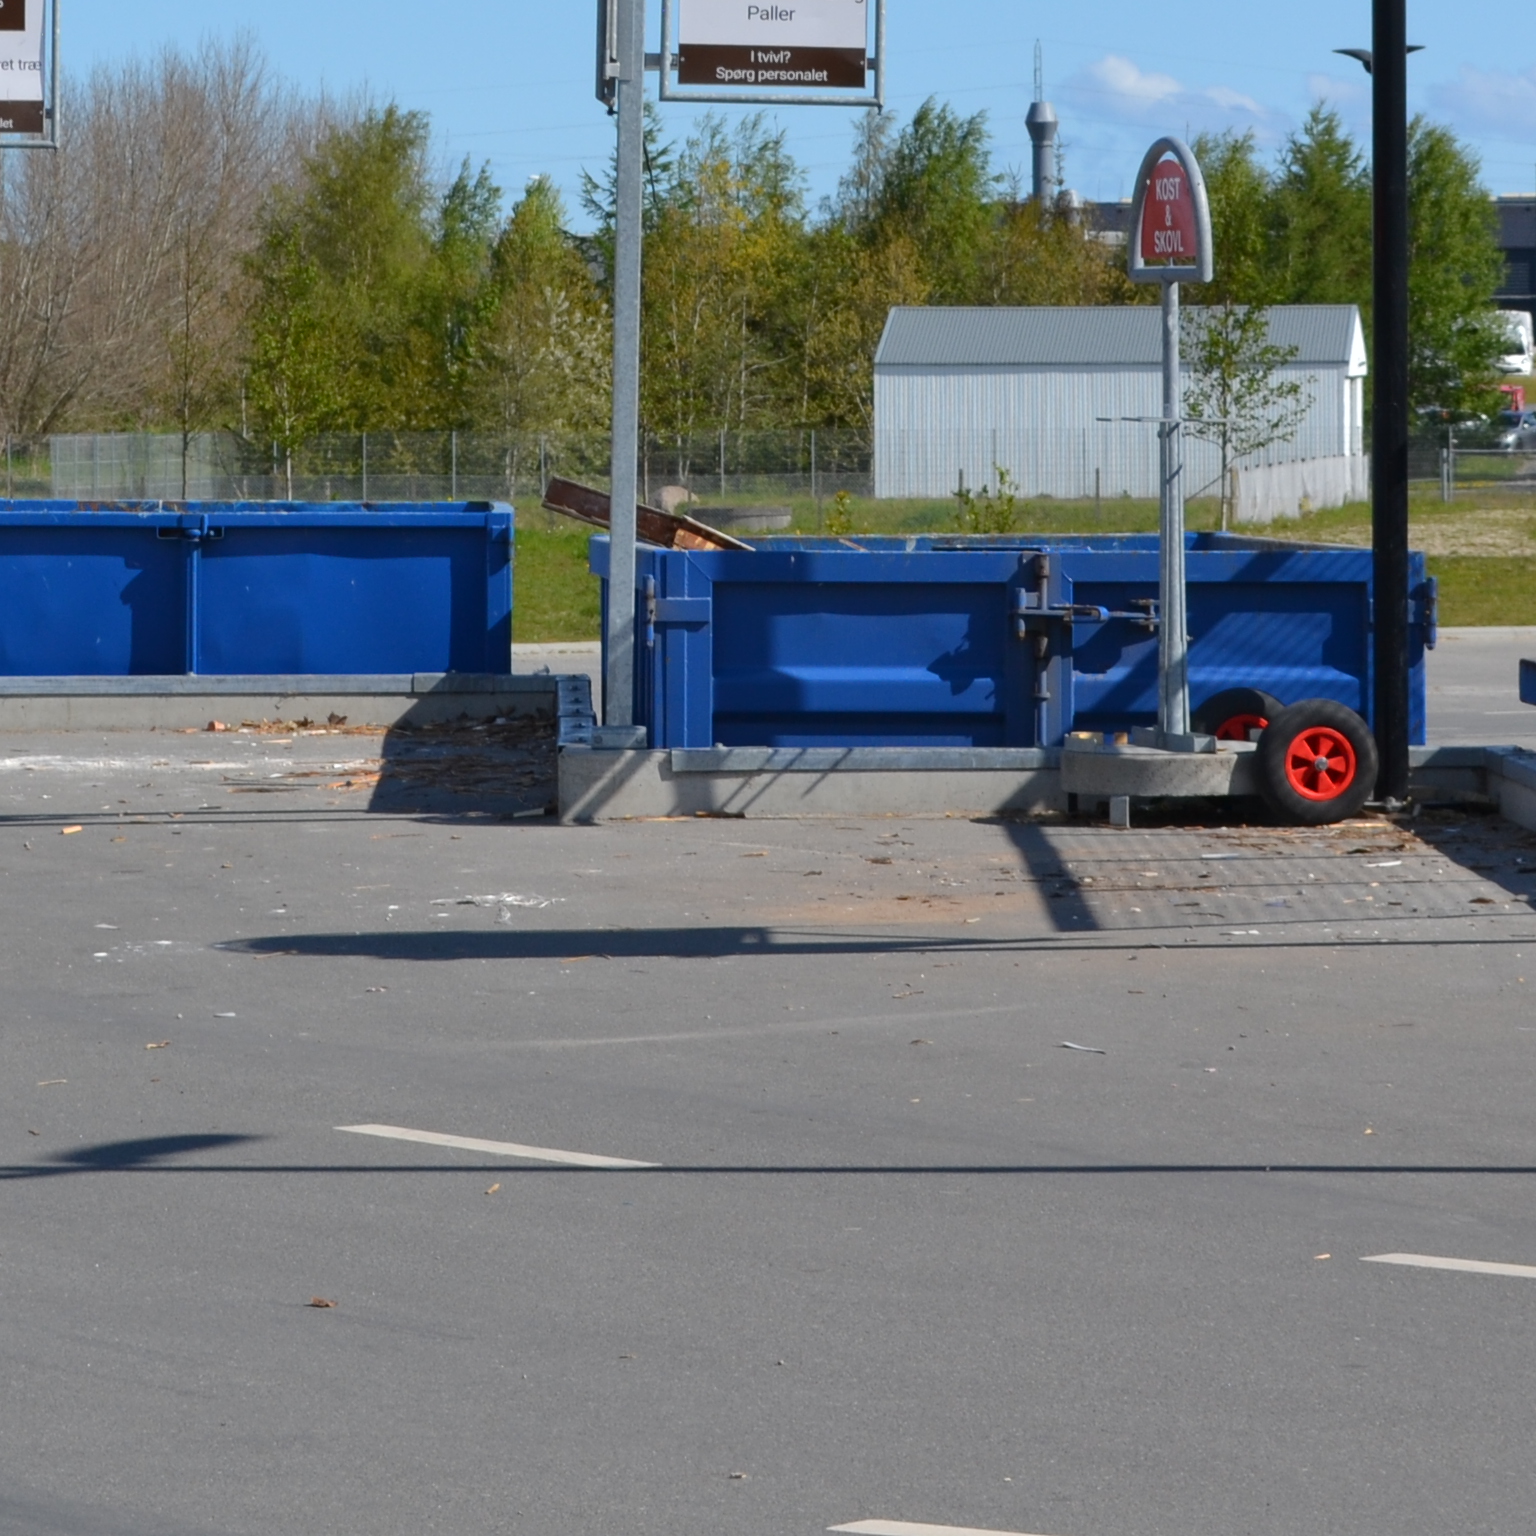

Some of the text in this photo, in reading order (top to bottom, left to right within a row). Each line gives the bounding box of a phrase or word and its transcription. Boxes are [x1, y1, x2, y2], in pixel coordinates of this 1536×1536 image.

[747, 5, 795, 21] Paller
[750, 50, 791, 63] I tvivl?
[18, 59, 42, 71] træ
[716, 67, 828, 82] Spørg personalet
[1155, 177, 1181, 201] KOST
[1165, 205, 1172, 226] &
[1154, 230, 1184, 253] SKOVL
